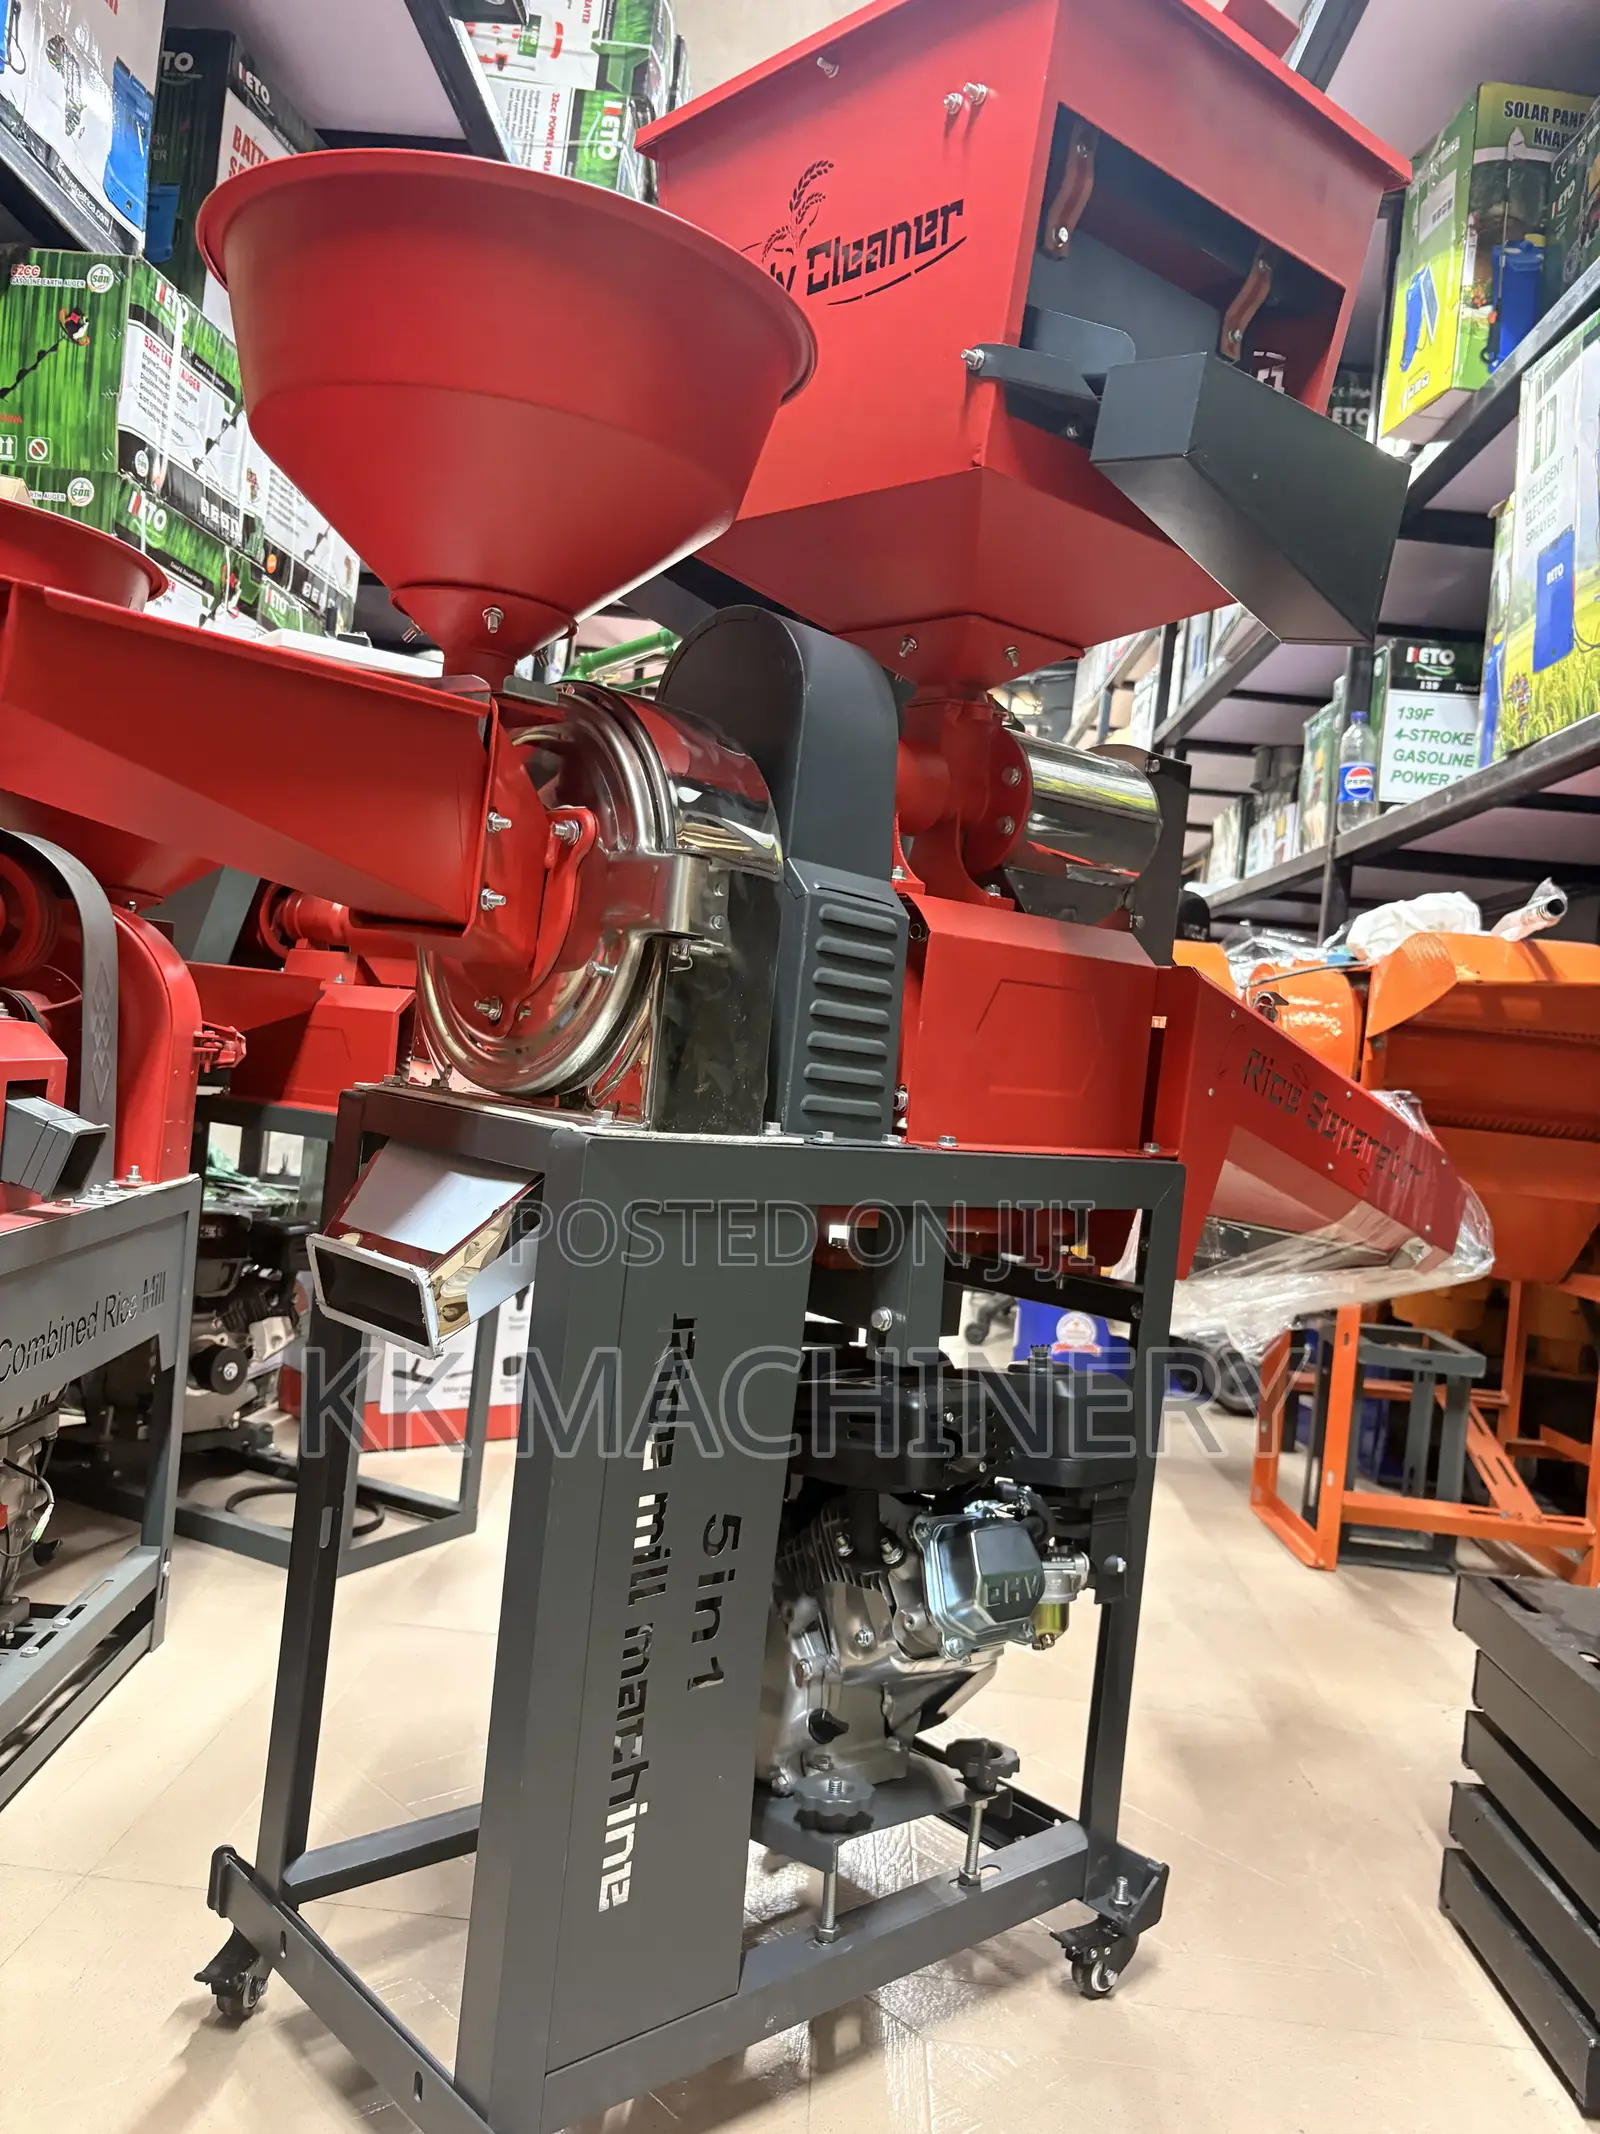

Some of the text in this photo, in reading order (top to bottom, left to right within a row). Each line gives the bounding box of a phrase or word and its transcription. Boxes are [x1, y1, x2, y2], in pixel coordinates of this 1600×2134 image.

[1504, 100, 1549, 123] SOLAR
[807, 199, 964, 296] Cleaner
[1329, 406, 1370, 425] ETO
[43, 492, 66, 502] AUGER
[1522, 455, 1565, 508] INTELLIGENT
[1525, 485, 1559, 526] ELECTRIC
[1525, 509, 1558, 548] SPRAYER
[1406, 646, 1456, 666] RETO
[1397, 706, 1434, 721] 139F
[1394, 728, 1476, 747] 4-STROKE
[1393, 748, 1475, 768] GASOLINE
[1390, 770, 1450, 786] POWER
[1243, 1049, 1302, 1115] Rice
[0, 1270, 167, 1384] Combined Rice Mill
[628, 1492, 671, 1606] mill
[687, 1513, 742, 1692] 5 in 1
[598, 1622, 654, 1913] machine
